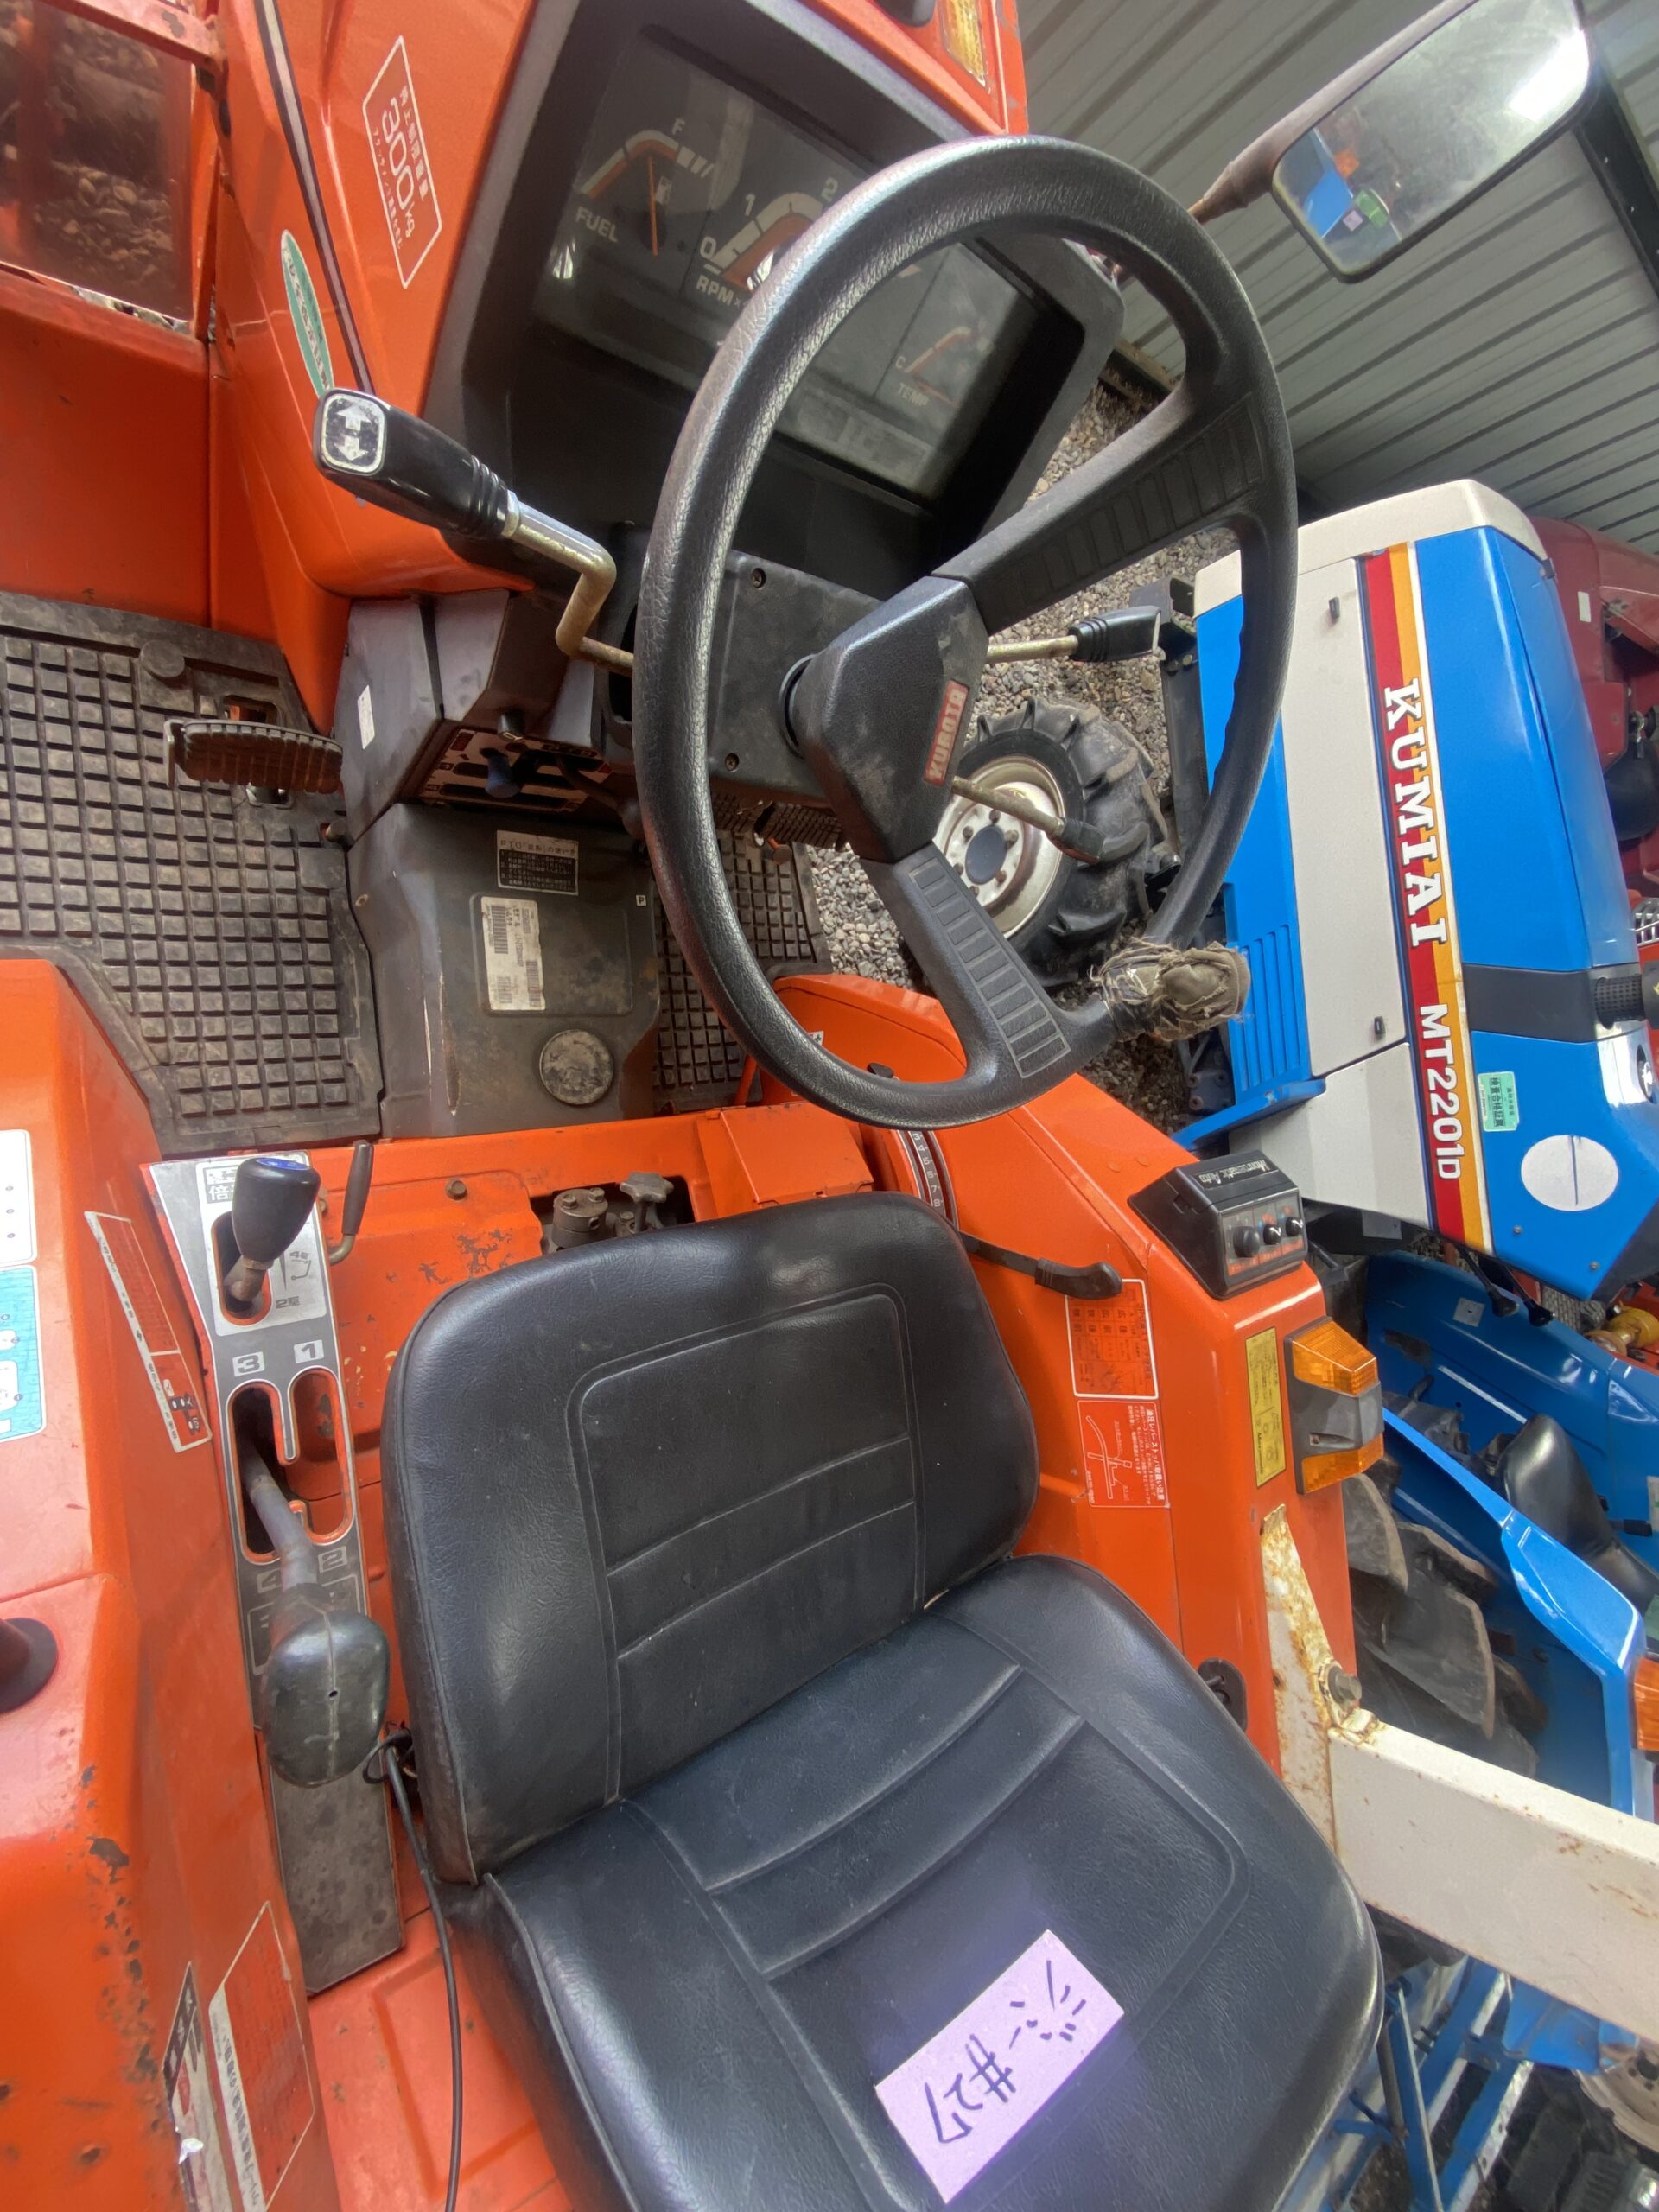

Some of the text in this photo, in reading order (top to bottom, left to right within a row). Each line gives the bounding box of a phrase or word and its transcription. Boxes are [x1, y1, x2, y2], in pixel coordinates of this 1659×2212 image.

[672, 118, 685, 136] F
[822, 177, 839, 201] 2
[744, 193, 757, 216] 1
[575, 207, 619, 244] FUEL
[897, 383, 931, 407] TEMP
[930, 686, 967, 782] KUBOTA
[1382, 677, 1461, 1180] KUMIAI MT2201D
[208, 1185, 234, 1201] 倍
[301, 1342, 316, 1359] 1
[237, 1355, 261, 1374] 3
[321, 1550, 343, 1570] 2
